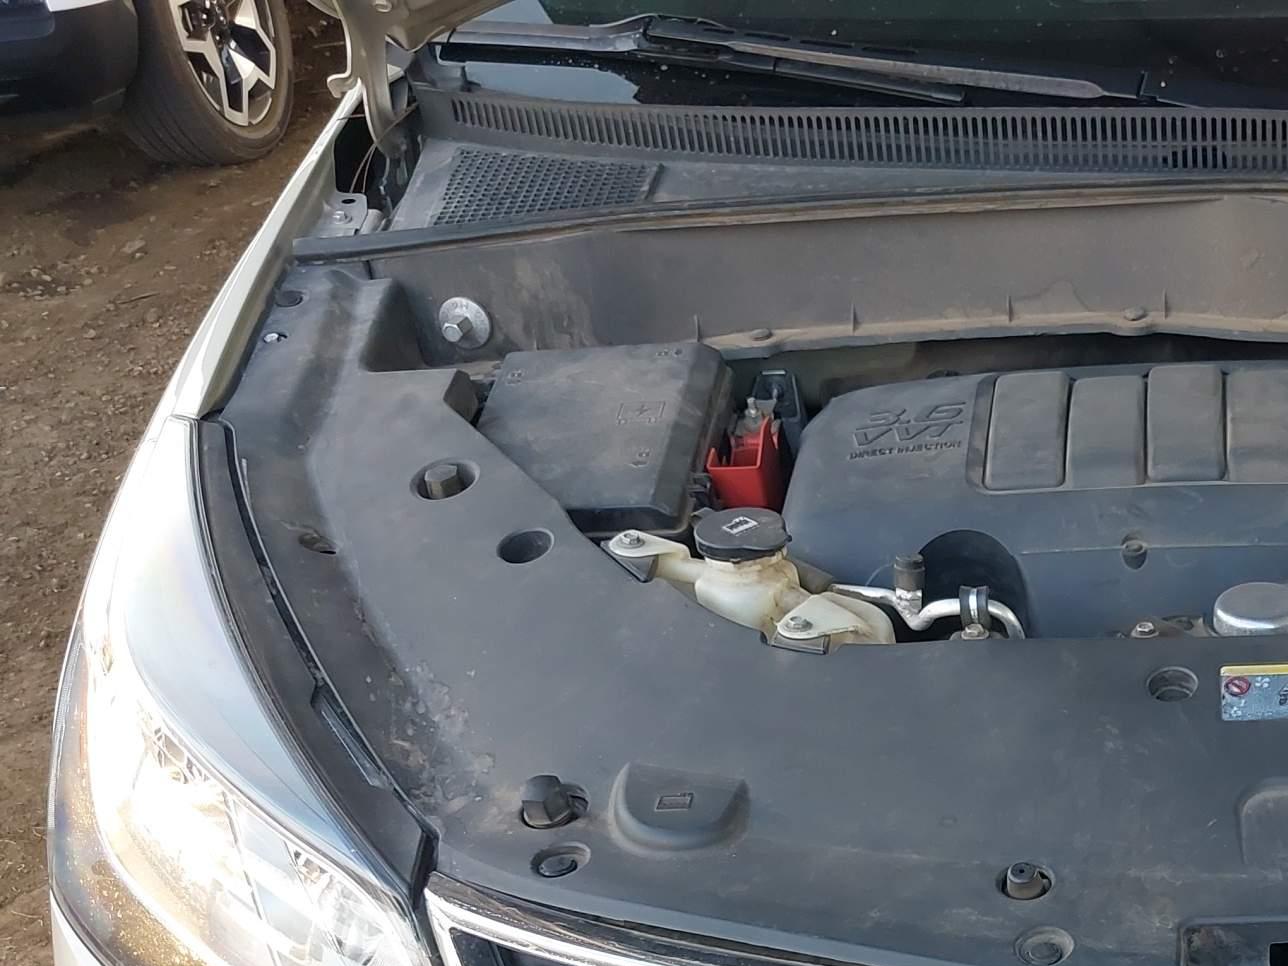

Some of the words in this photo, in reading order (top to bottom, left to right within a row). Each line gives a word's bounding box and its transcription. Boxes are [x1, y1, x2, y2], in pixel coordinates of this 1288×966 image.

[866, 401, 967, 427] 3.6
[852, 420, 965, 447] VVT
[849, 446, 893, 460] DIRECT
[897, 440, 962, 455] INJECTION
